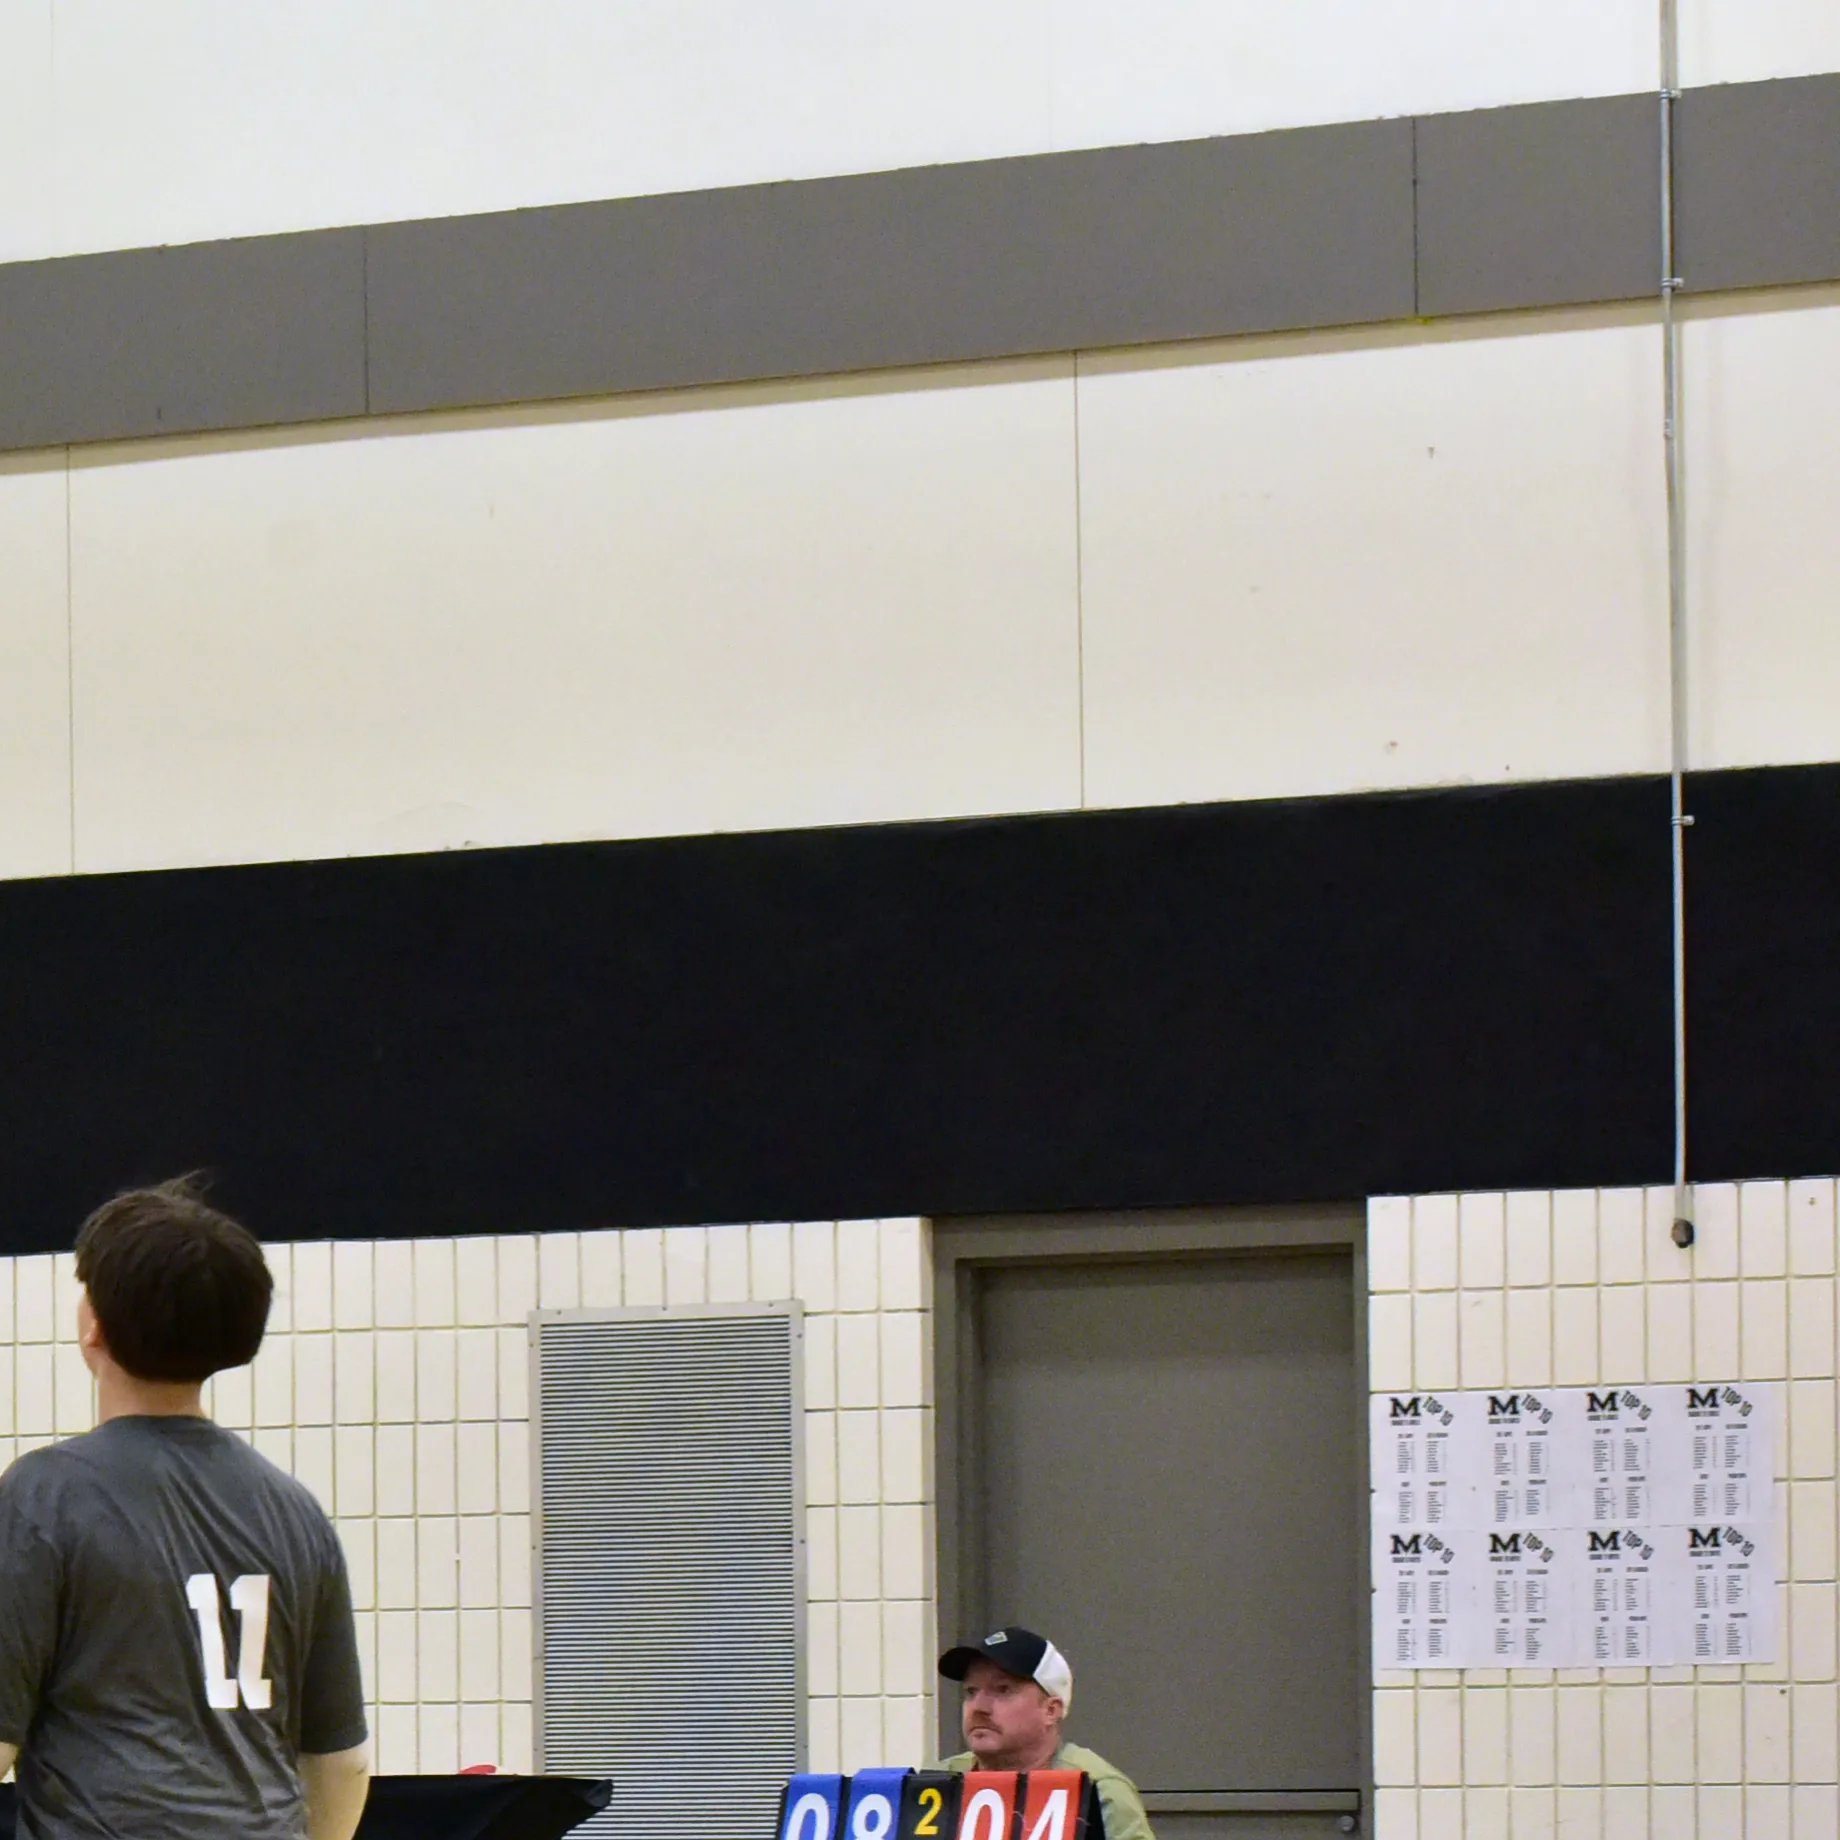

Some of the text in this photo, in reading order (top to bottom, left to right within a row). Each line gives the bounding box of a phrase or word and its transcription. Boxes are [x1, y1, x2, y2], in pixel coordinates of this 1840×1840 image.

[1389, 1396, 1422, 1418] M
[1488, 1394, 1520, 1416] M
[1586, 1391, 1619, 1413] M
[1686, 1387, 1719, 1409] M
[1389, 1533, 1423, 1555] M
[1488, 1532, 1521, 1554] M
[1587, 1530, 1621, 1552] M
[1688, 1526, 1721, 1549] M
[185, 1573, 273, 1710] 11
[914, 1788, 943, 1835] 2
